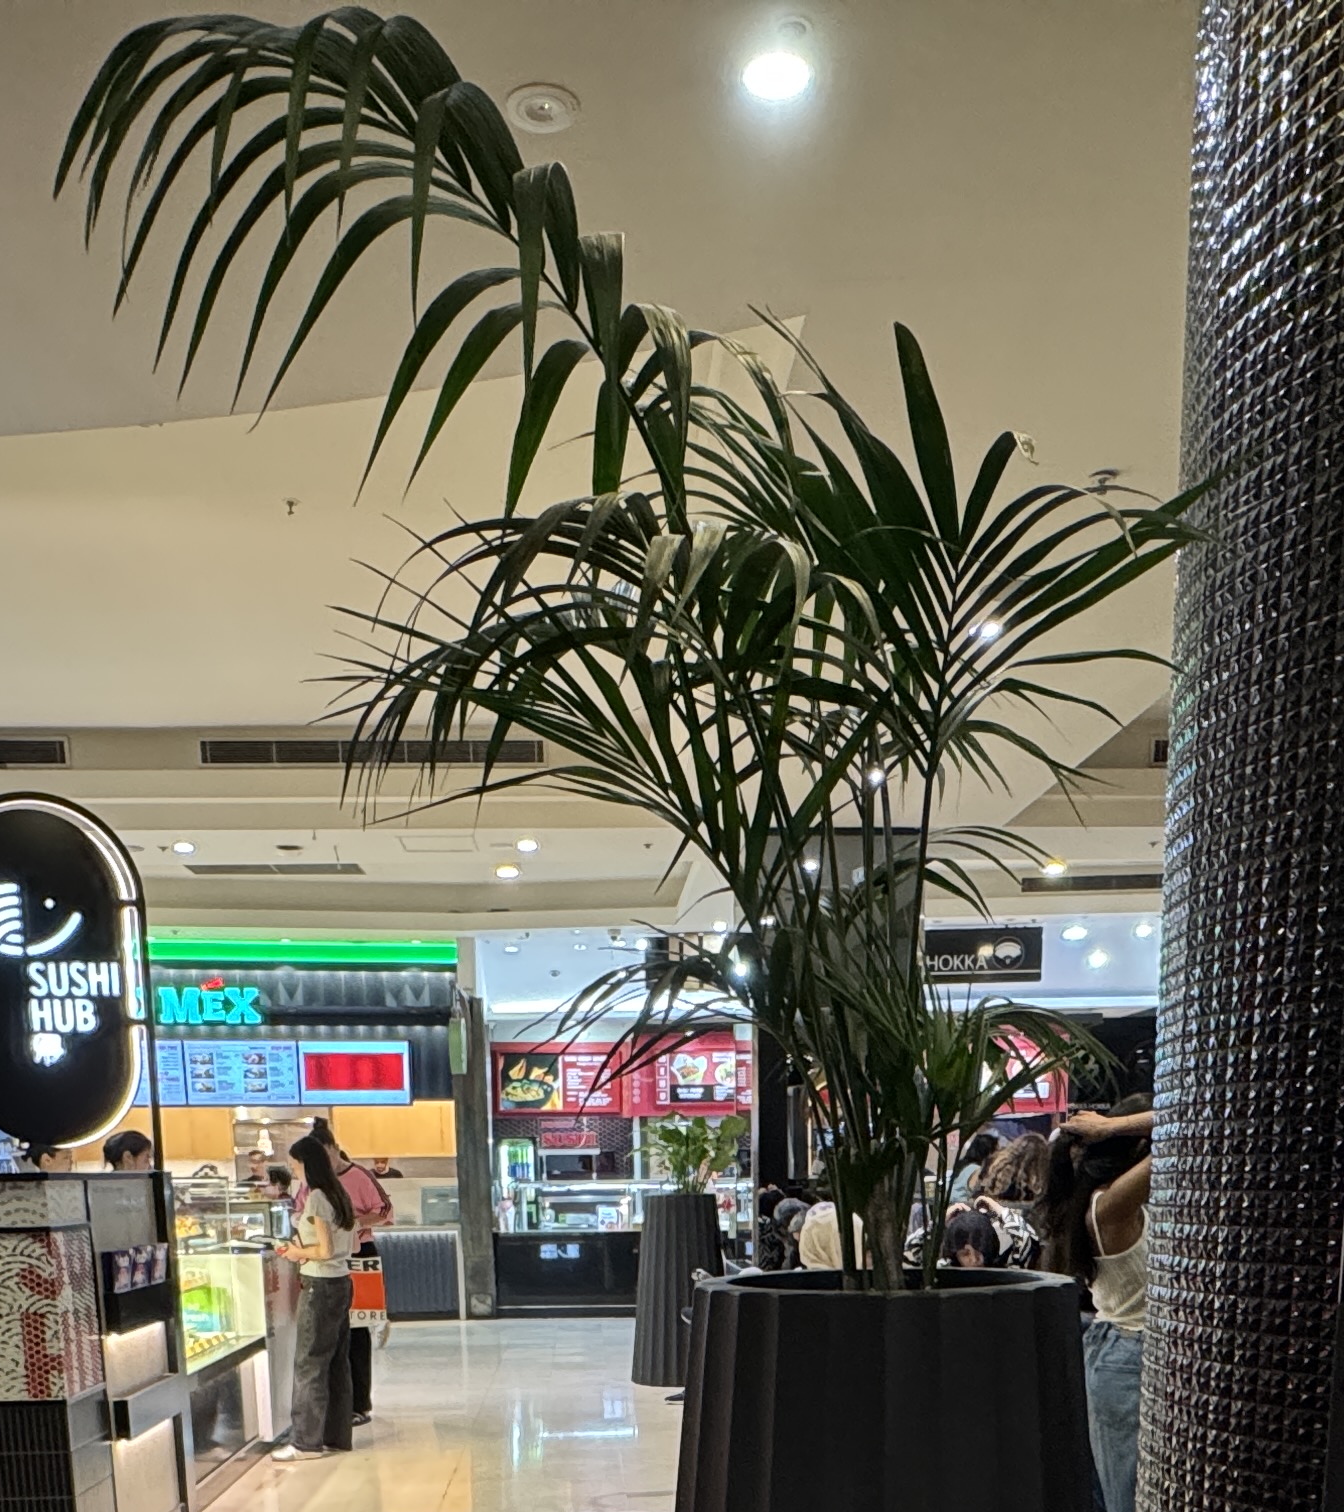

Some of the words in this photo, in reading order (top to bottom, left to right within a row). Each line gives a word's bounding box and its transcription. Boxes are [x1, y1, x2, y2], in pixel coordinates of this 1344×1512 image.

[27, 961, 121, 998] SUSHI
[927, 954, 988, 971] HOKKA
[29, 998, 98, 1033] HUB
[158, 986, 263, 1025] MEX
